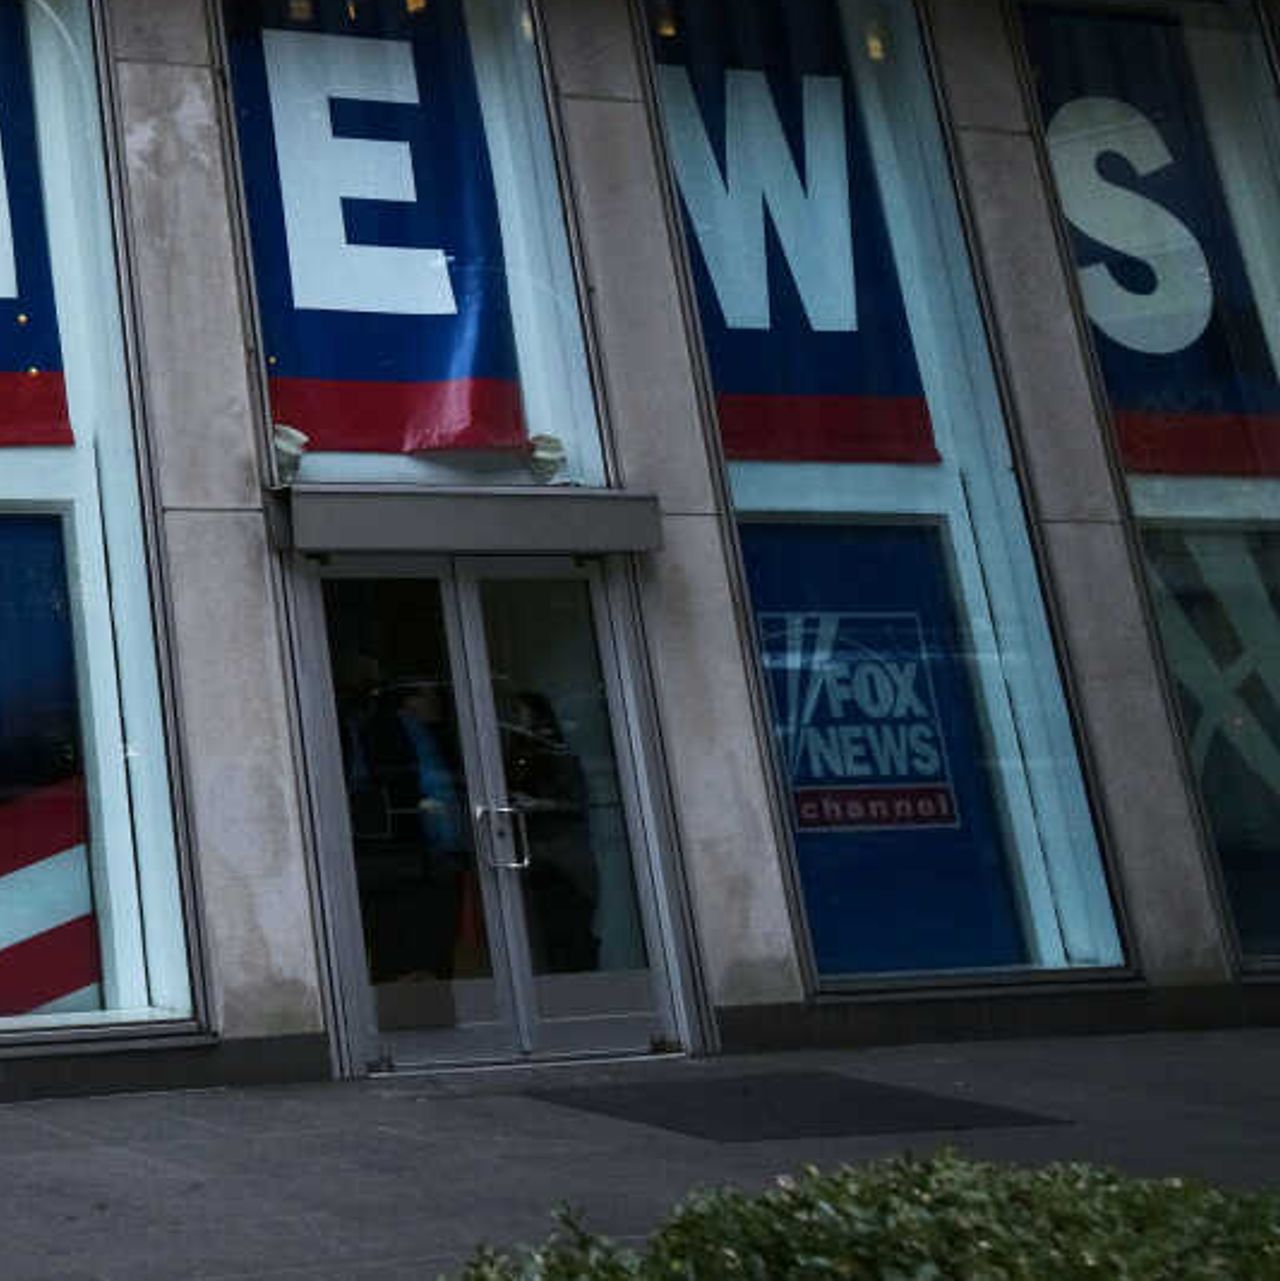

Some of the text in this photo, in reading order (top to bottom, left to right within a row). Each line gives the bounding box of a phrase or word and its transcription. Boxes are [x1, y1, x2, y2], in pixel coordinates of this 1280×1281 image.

[826, 659, 928, 720] FOX
[800, 722, 938, 779] NEWS
[799, 793, 951, 820] channel
